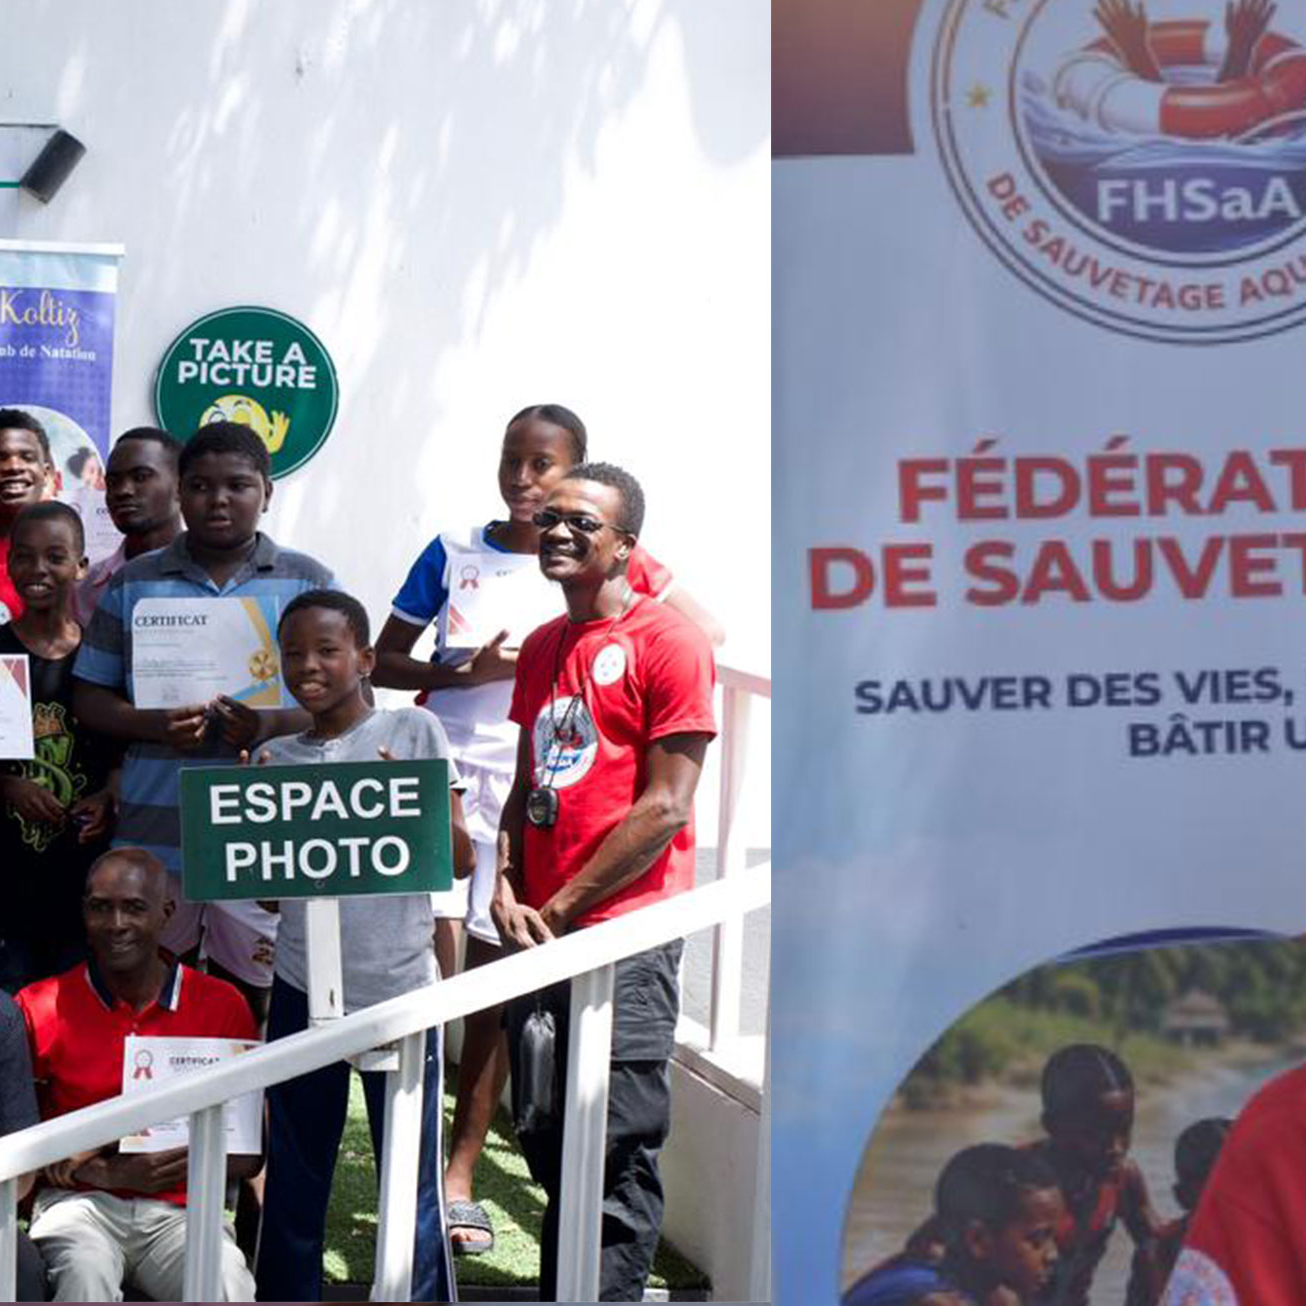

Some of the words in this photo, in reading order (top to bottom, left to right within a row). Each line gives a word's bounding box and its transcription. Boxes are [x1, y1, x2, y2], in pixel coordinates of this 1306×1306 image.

[1098, 178, 1300, 223] FHSaA
[987, 173, 1029, 222] DE
[1022, 220, 1223, 310] SAUVETAGE
[0, 289, 79, 346] Koltiz
[19, 344, 36, 358] de
[40, 344, 97, 362] Natation
[190, 338, 274, 364] TAKE
[282, 342, 306, 365] A
[178, 360, 316, 389] PICTURE
[808, 543, 936, 611] DE
[135, 614, 209, 628] CERTIFICAT
[856, 674, 1050, 715] SAUVER
[1066, 671, 1161, 709] DES
[1173, 665, 1294, 707] VIES,
[1127, 713, 1270, 758] BÂTIR
[209, 777, 421, 825] ESPACE
[225, 836, 410, 882] PHOTO
